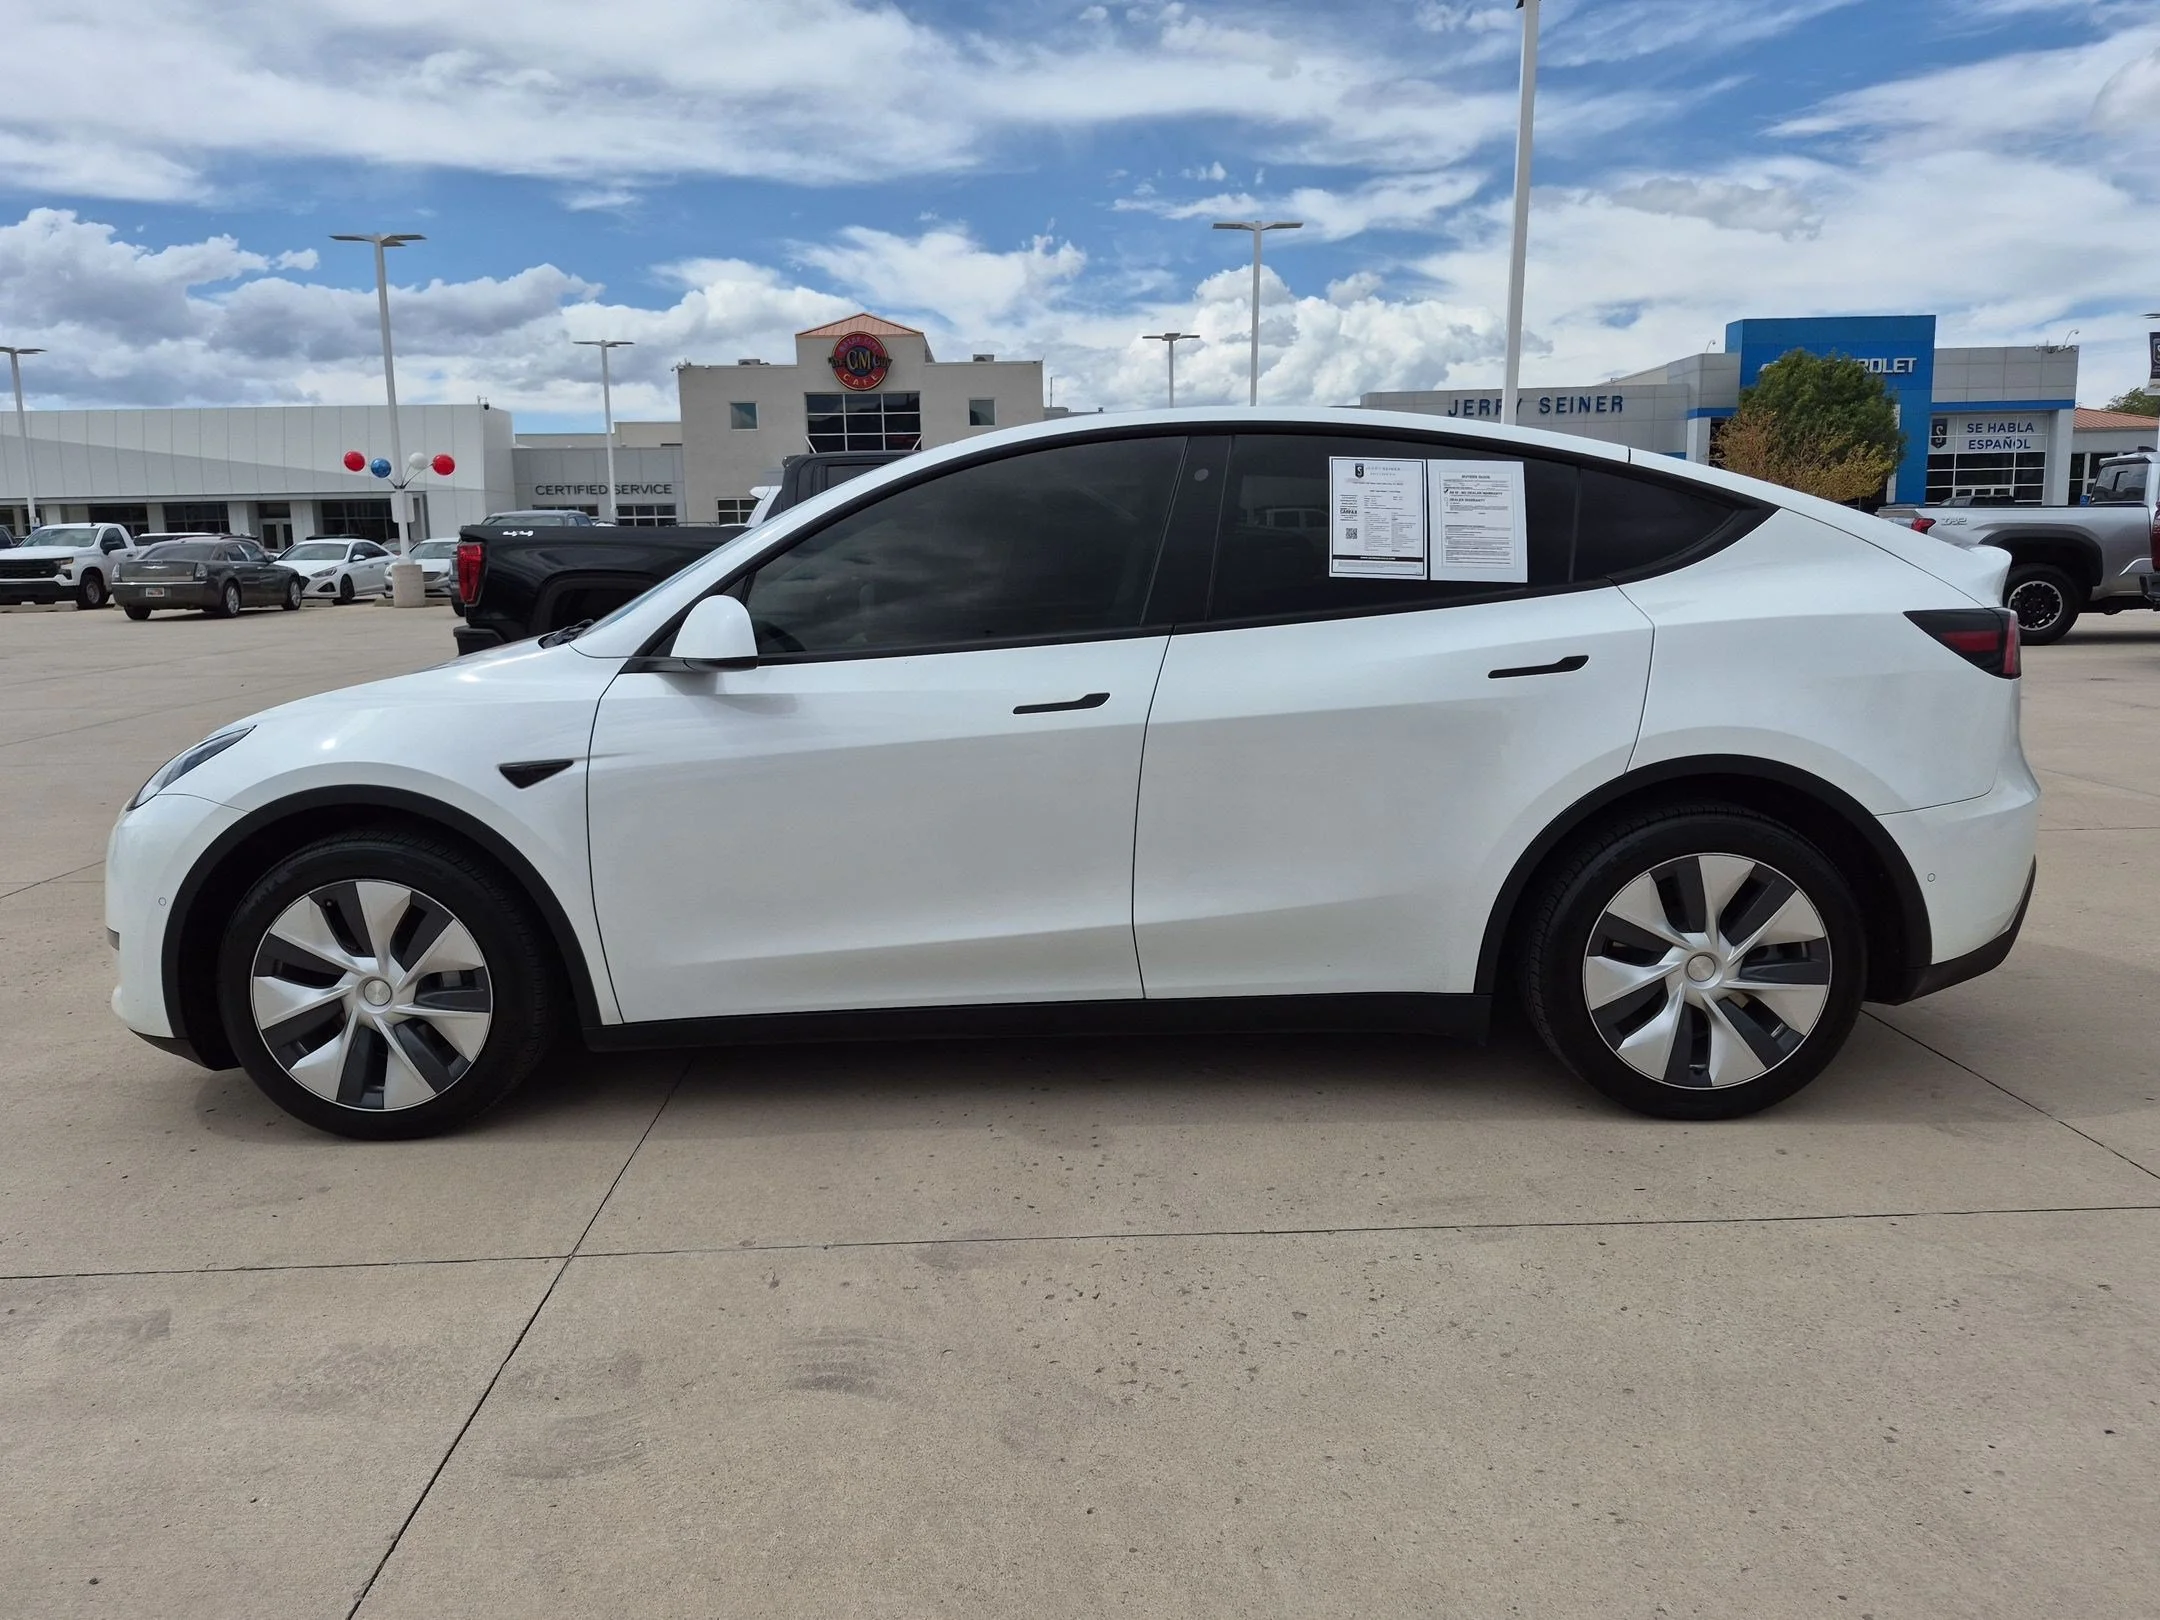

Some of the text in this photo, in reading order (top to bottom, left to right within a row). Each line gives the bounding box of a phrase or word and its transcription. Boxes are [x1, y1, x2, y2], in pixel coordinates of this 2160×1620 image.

[1539, 395, 1624, 414] SEINER
[1967, 422, 2035, 433] SE HABLA
[1968, 436, 2031, 450] ESPAÑOL
[535, 484, 673, 496] CERTIFIED SERVICE
